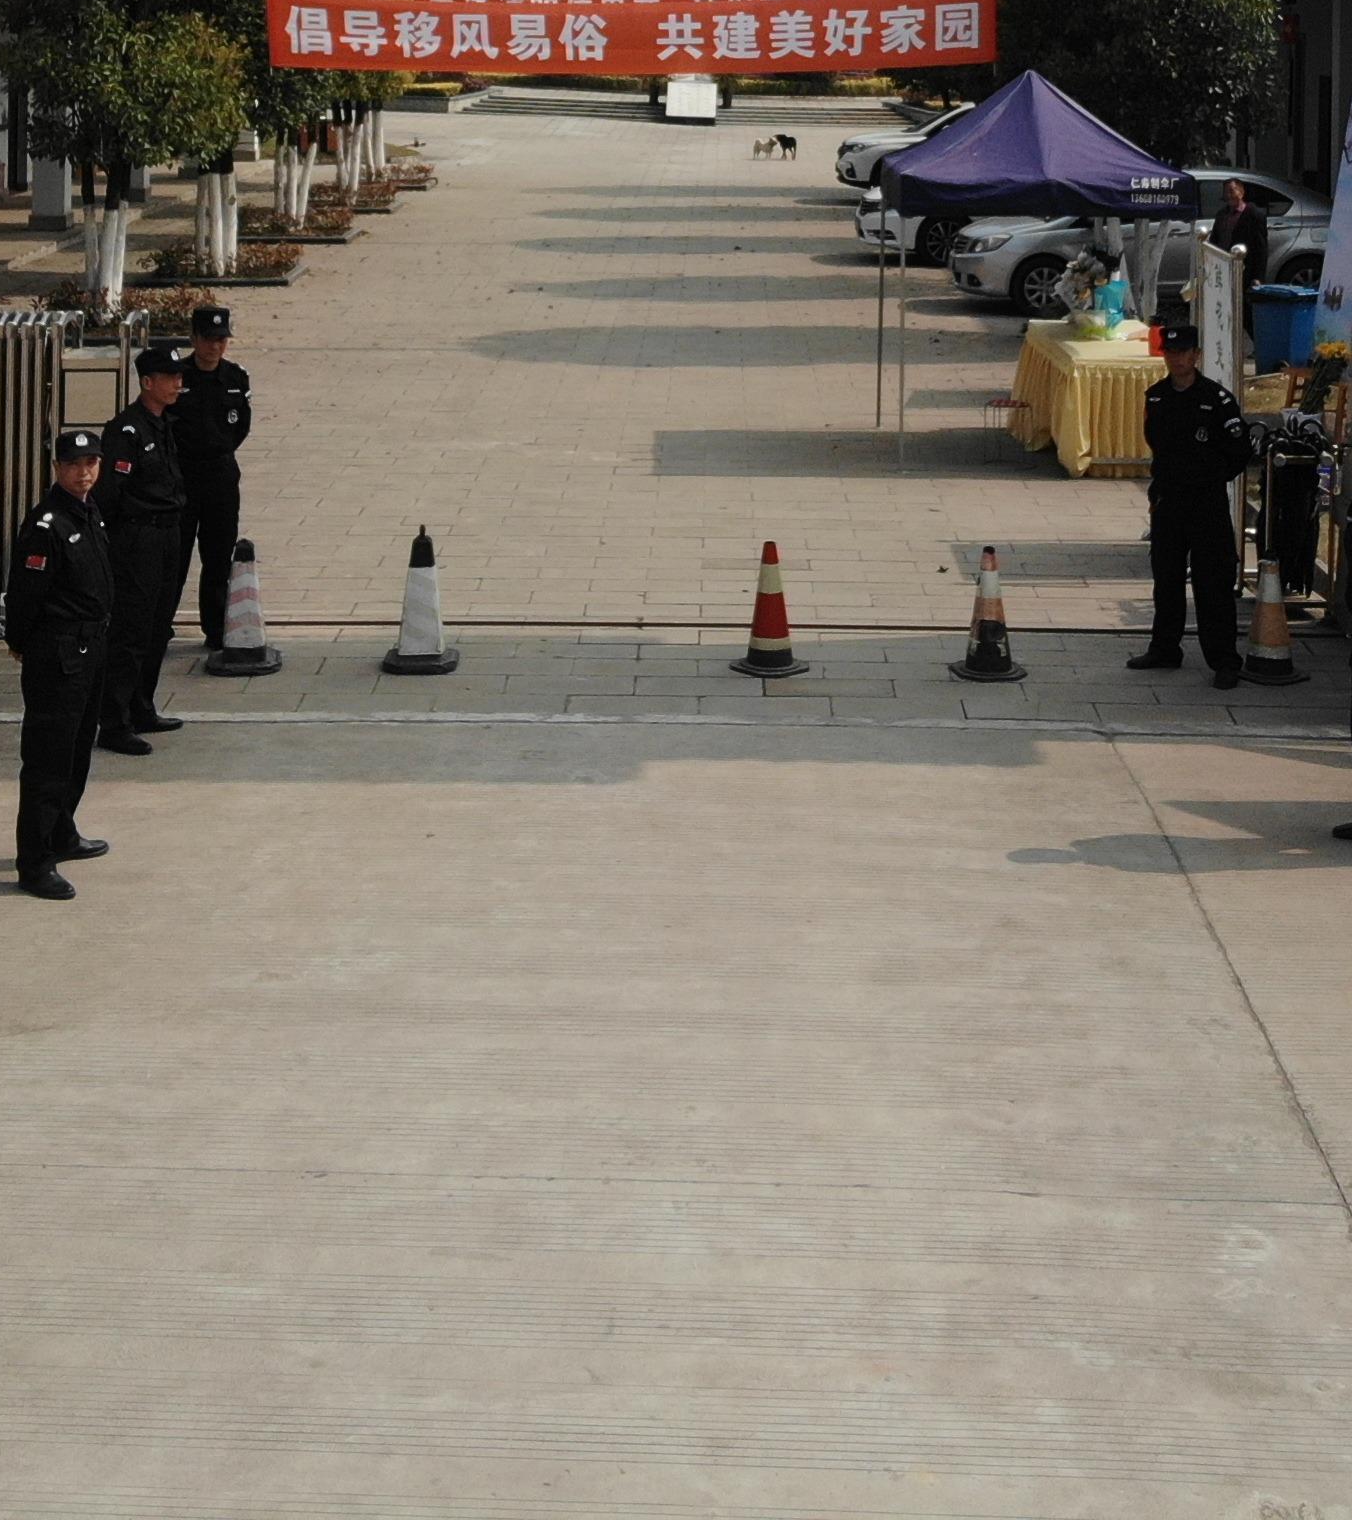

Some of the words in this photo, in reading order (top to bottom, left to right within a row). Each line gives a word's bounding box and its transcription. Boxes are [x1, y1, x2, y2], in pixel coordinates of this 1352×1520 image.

[284, 4, 608, 63] 倡导移风易俗
[656, 1, 981, 61] 共建美好家园
